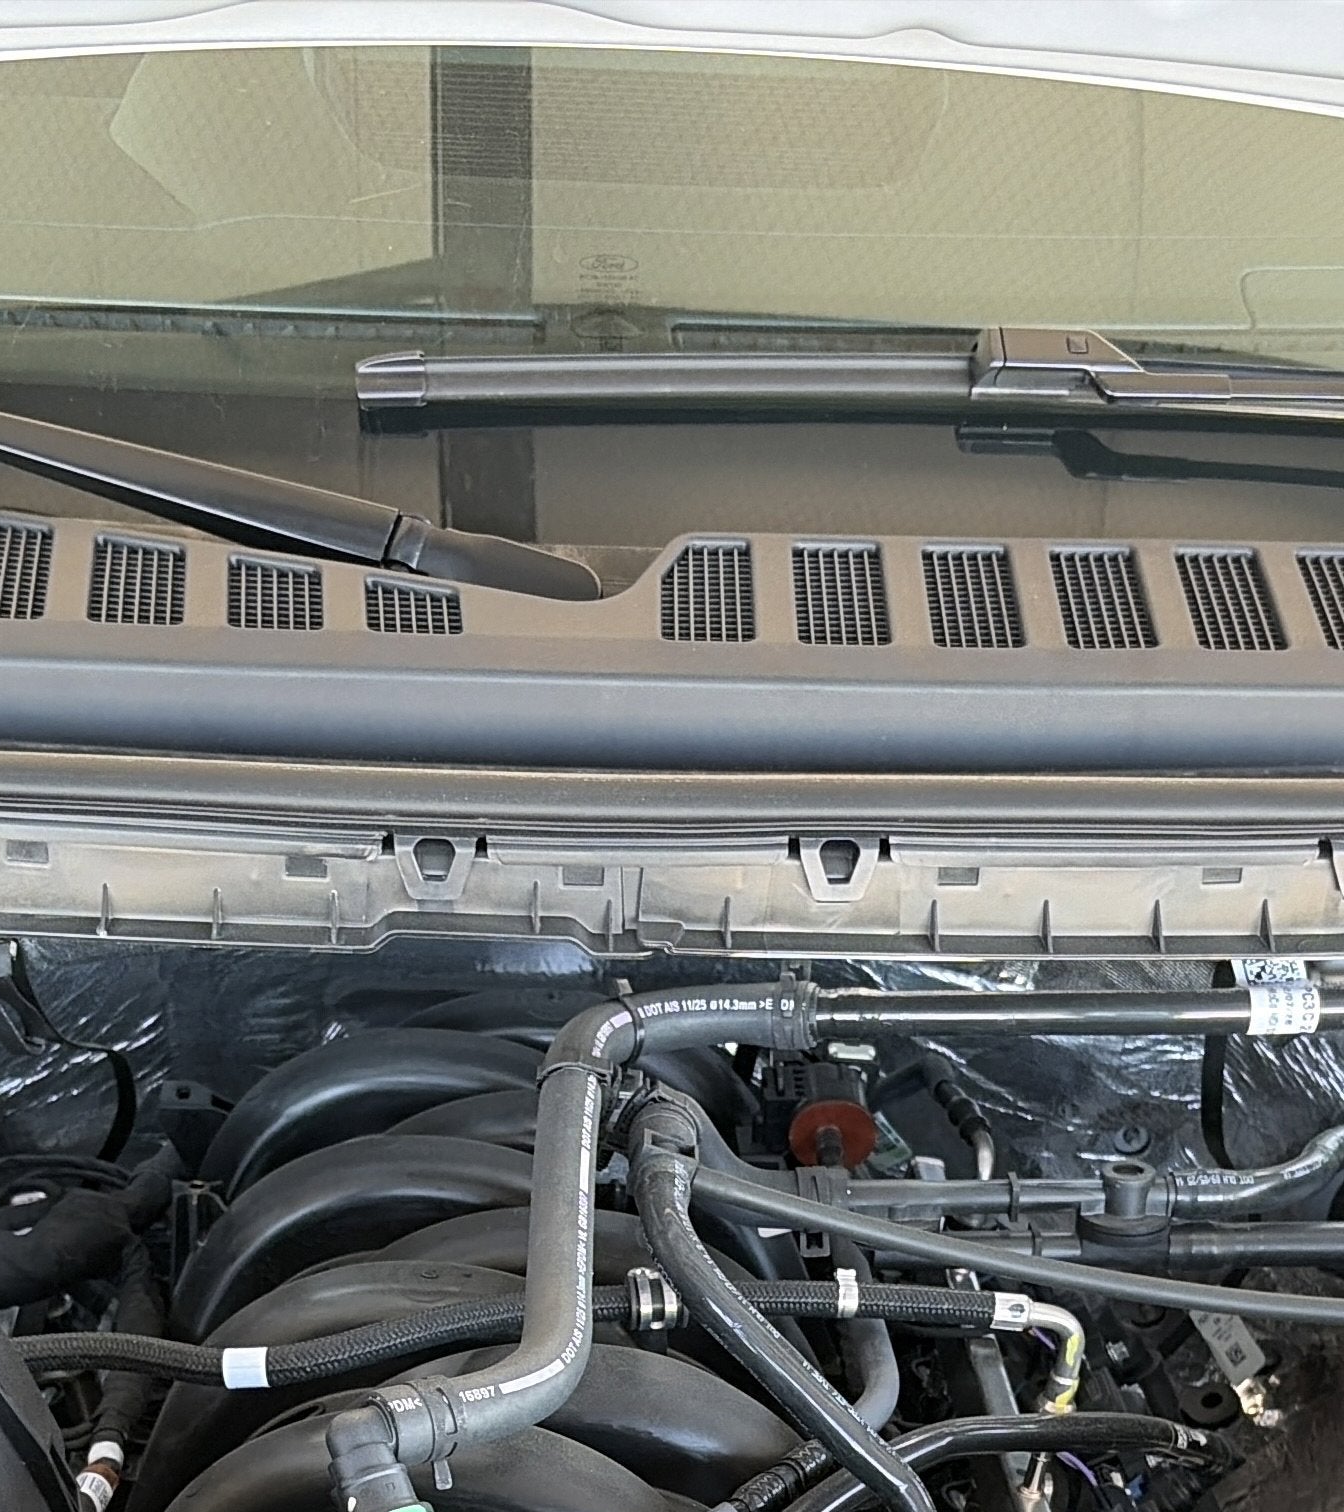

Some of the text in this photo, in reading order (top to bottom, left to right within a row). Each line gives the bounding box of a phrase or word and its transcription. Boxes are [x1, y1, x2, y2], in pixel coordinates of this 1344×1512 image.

[591, 256, 626, 271] Ford
[645, 1003, 663, 1018] DOT
[682, 998, 707, 1011] 11/25
[561, 1341, 577, 1364] DOT
